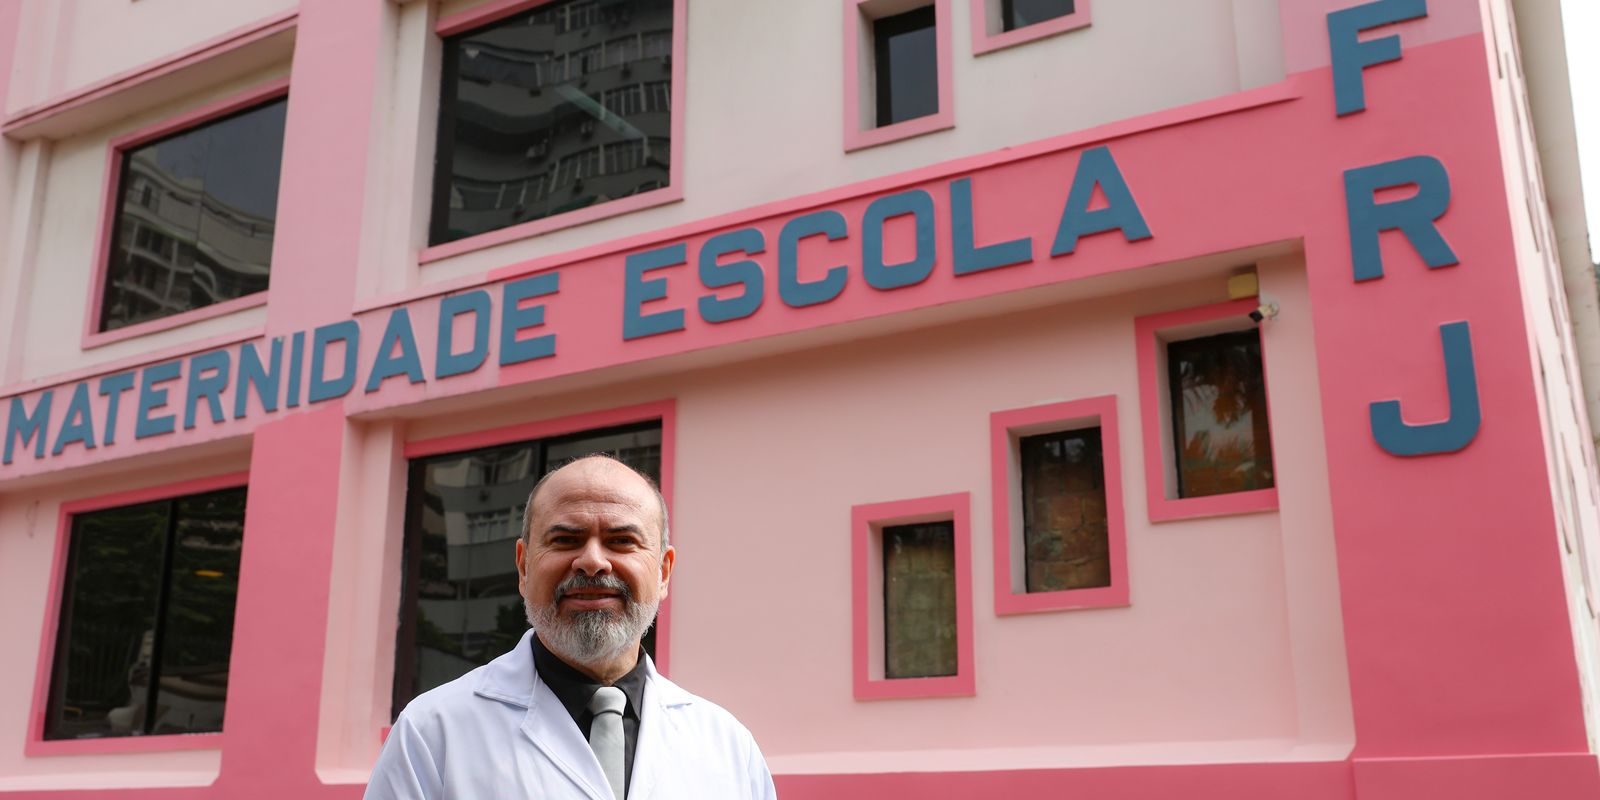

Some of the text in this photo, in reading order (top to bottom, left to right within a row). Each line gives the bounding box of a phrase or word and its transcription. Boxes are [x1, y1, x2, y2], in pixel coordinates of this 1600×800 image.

[3, 146, 1152, 464] MATERNIDADE ESCOLA
[1327, 0, 1481, 456] FRJ
